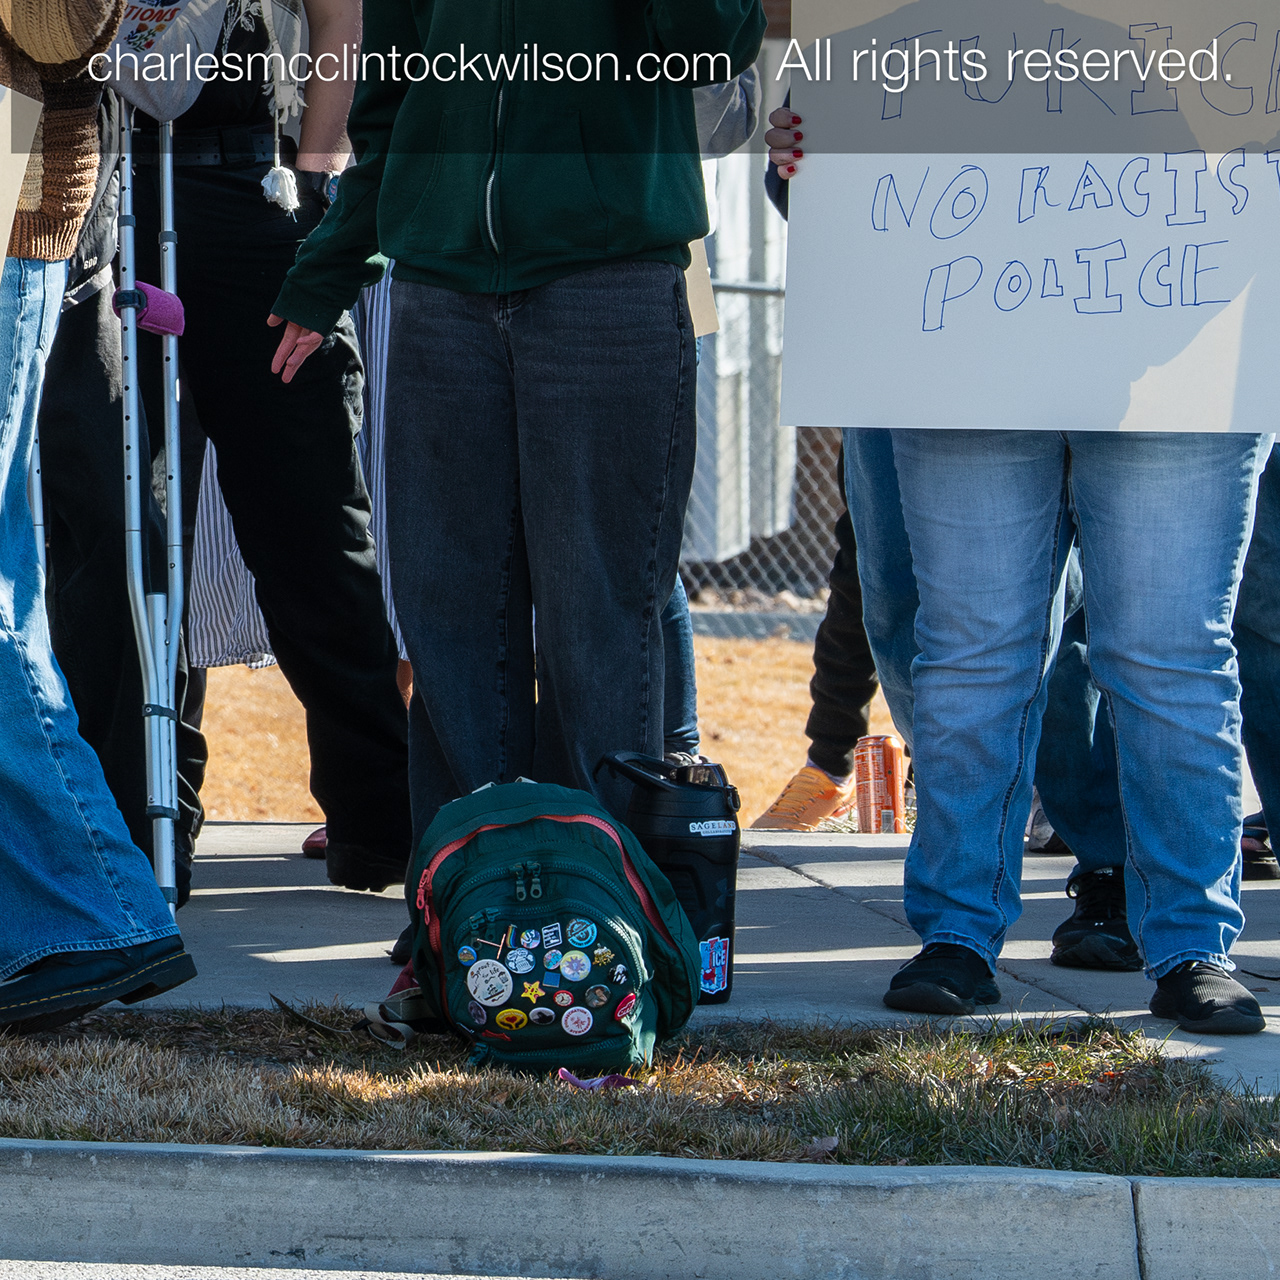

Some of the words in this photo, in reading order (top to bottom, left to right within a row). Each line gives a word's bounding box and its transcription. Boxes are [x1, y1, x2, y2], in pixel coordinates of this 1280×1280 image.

[1128, 21, 1280, 115] IC
[871, 165, 989, 240] NO
[922, 239, 1231, 332] POLICE
